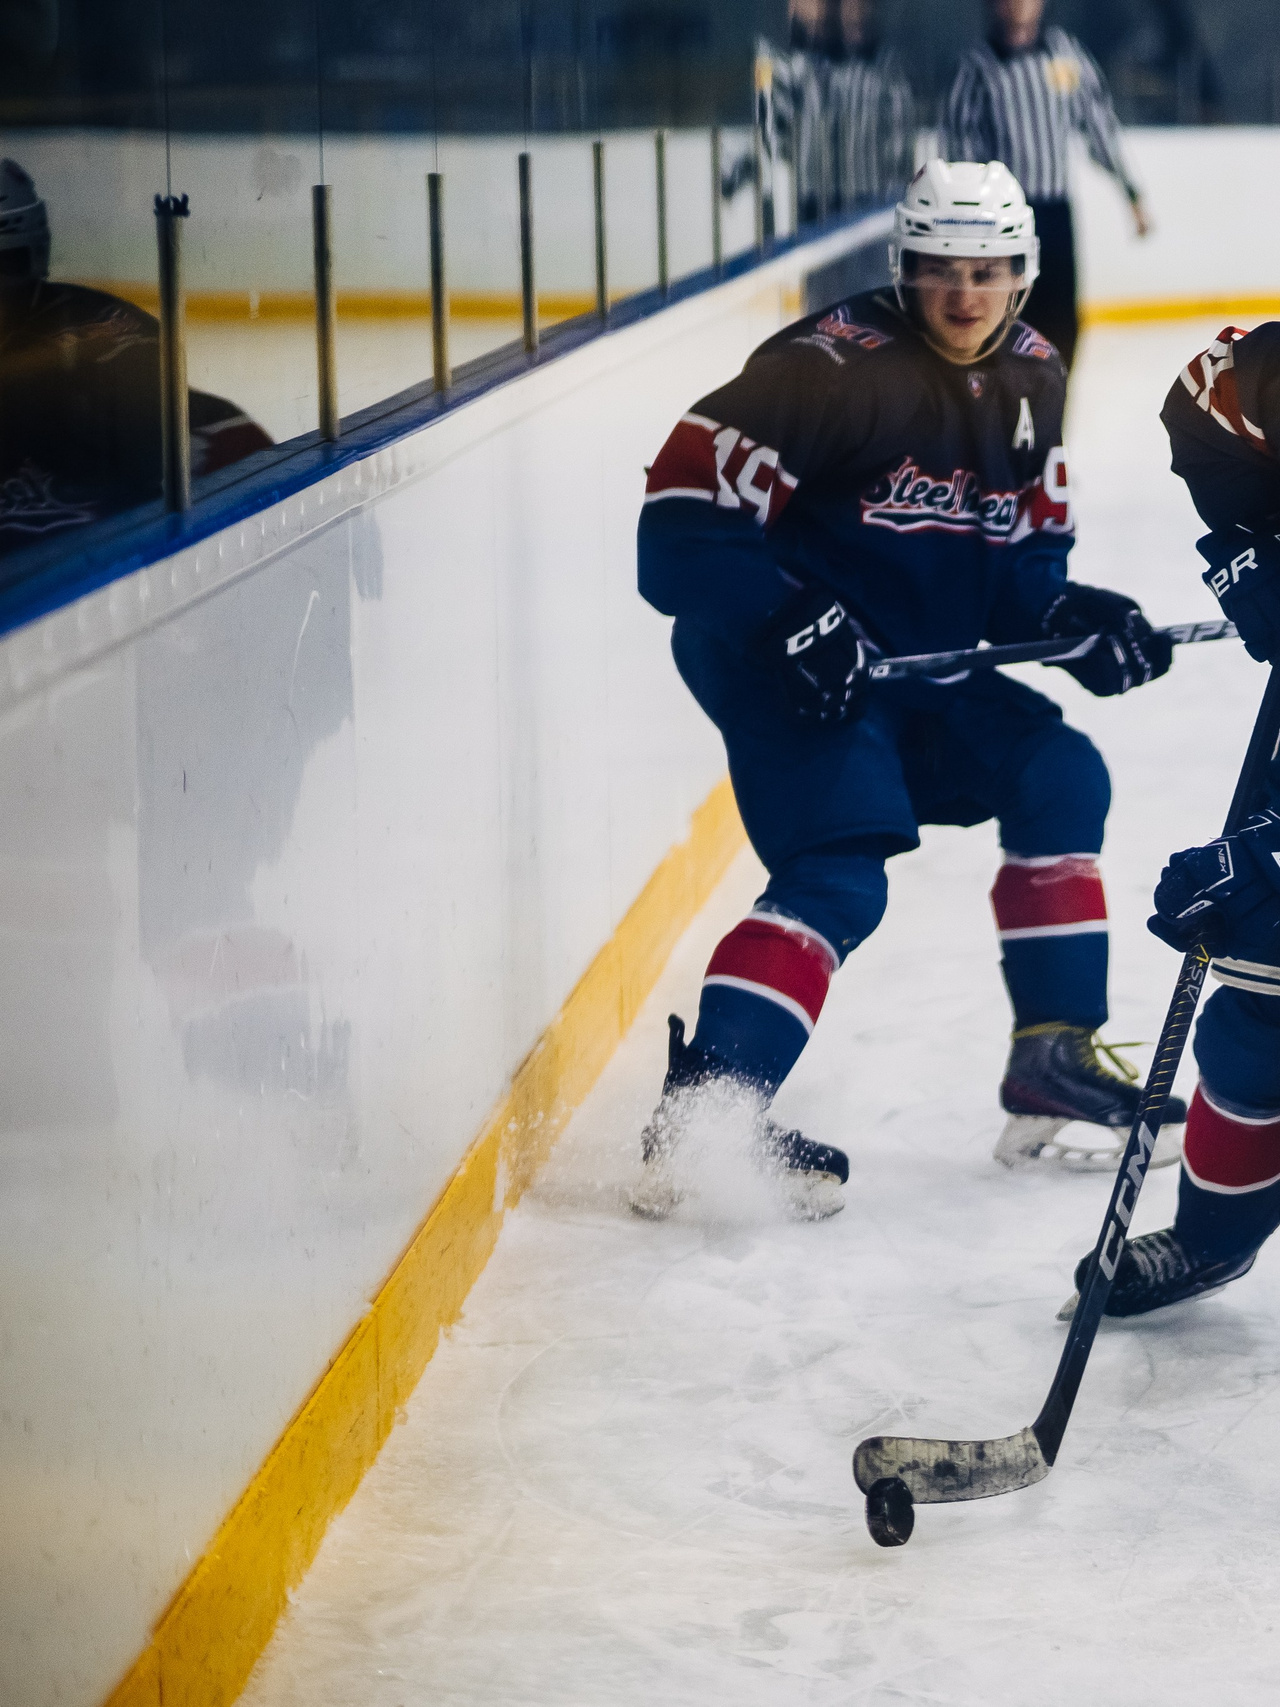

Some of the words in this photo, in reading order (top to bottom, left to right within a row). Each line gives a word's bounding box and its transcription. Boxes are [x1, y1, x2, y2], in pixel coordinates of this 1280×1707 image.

[1011, 397, 1036, 451] A
[712, 426, 780, 526] 19
[1099, 1121, 1157, 1282] CCM
